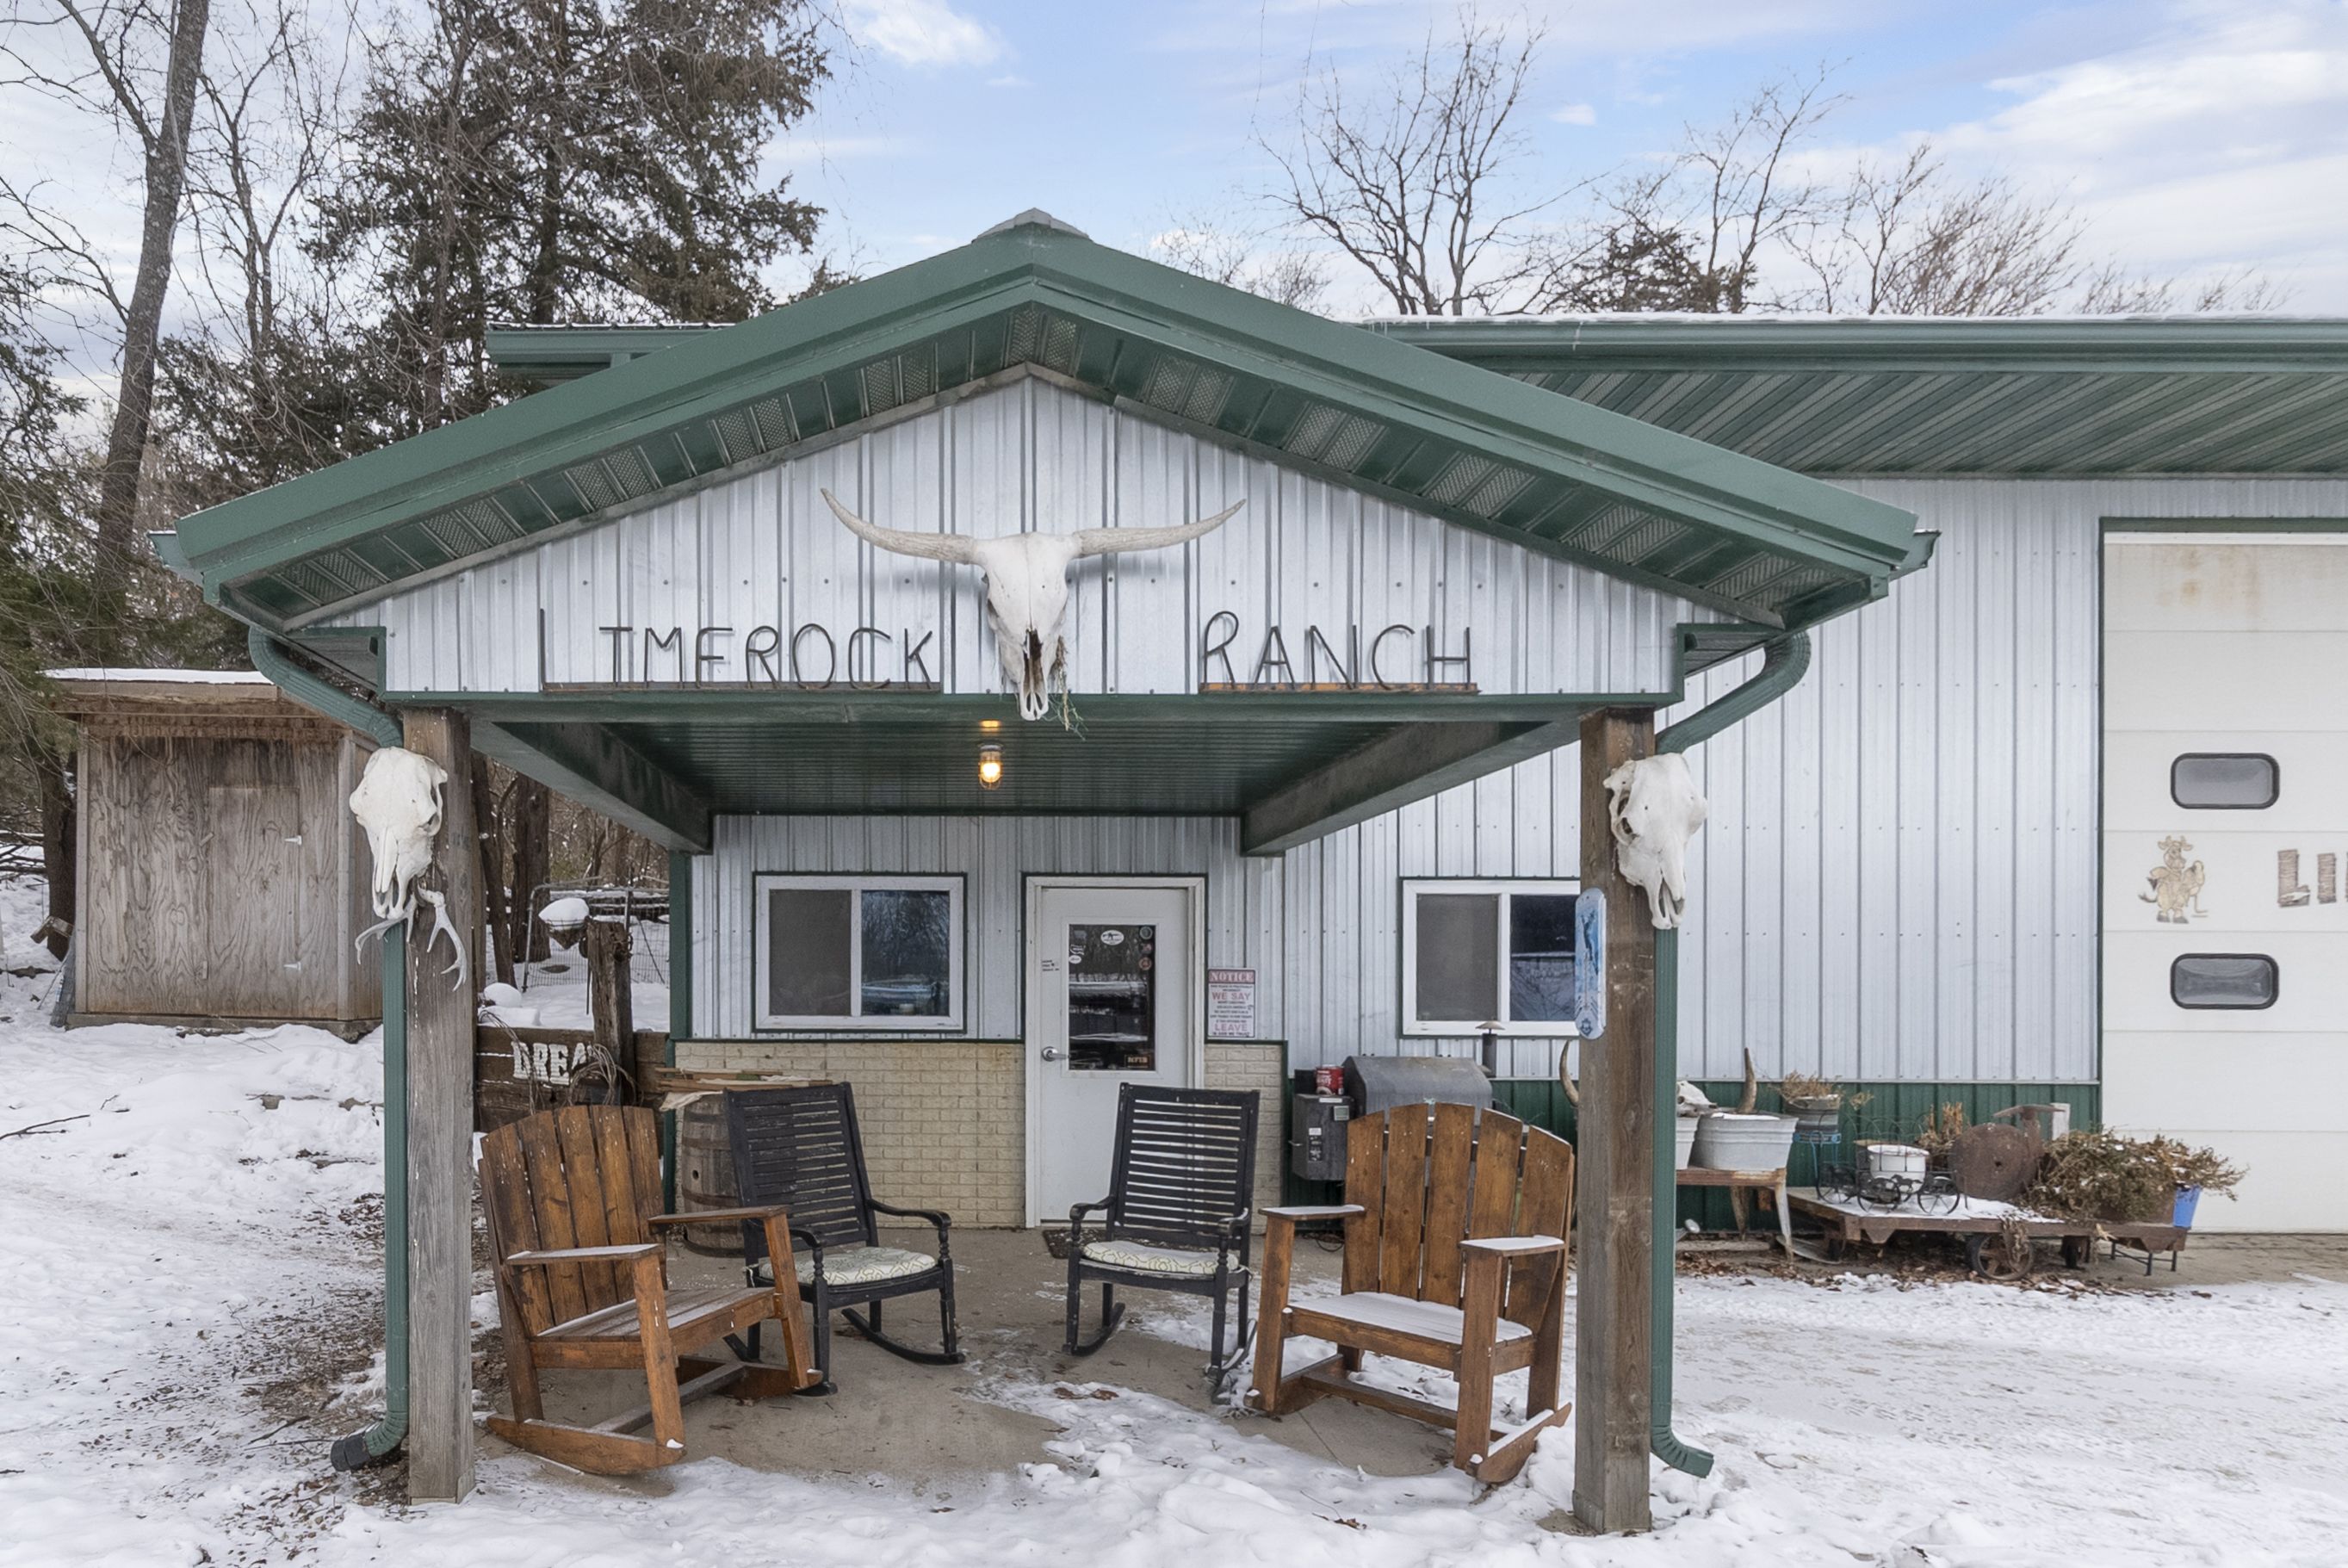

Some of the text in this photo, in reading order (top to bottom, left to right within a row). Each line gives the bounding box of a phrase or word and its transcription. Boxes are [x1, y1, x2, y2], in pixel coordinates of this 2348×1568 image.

[1205, 610, 1471, 690] RANCH
[2277, 849, 2348, 908] LI
[1211, 971, 1254, 981] NOTICE
[1211, 992, 1250, 1001] WE SAY
